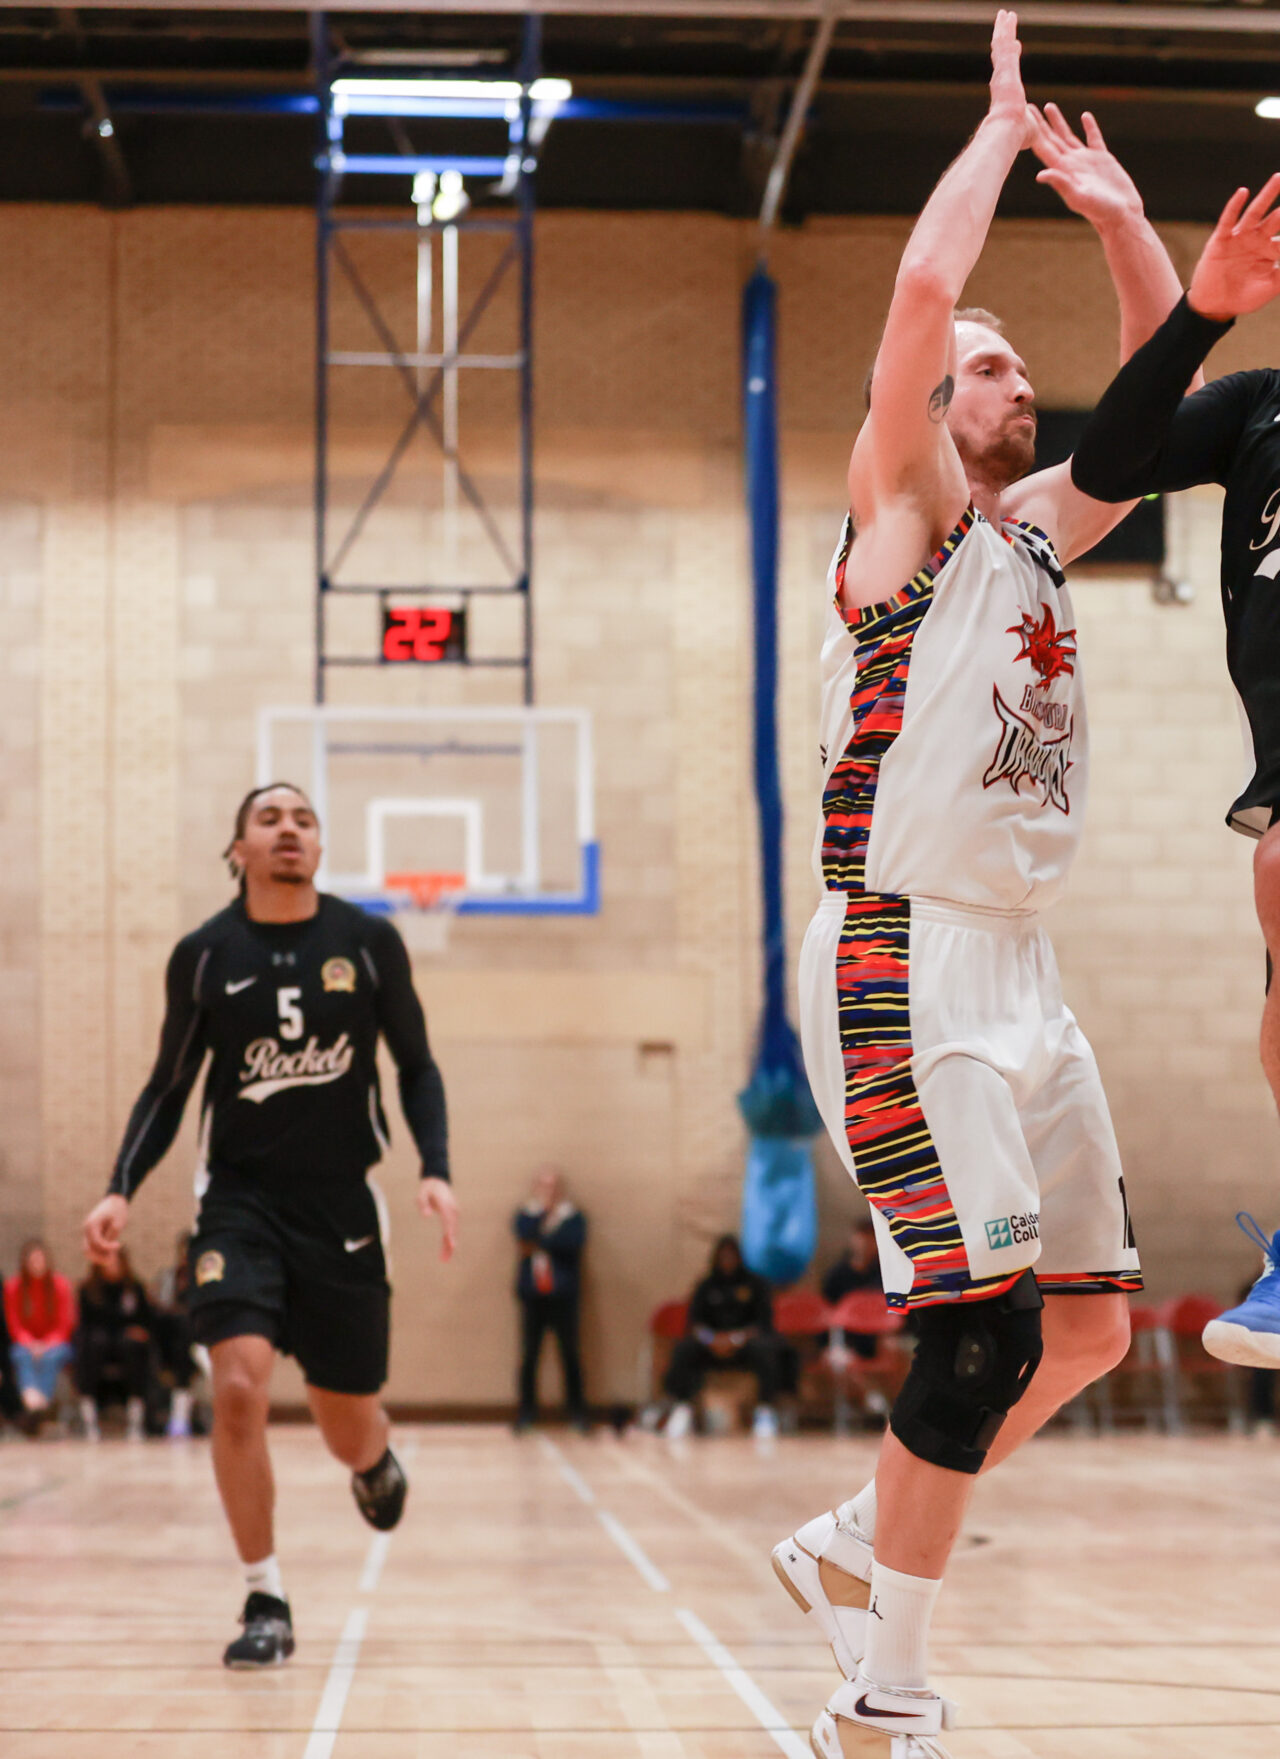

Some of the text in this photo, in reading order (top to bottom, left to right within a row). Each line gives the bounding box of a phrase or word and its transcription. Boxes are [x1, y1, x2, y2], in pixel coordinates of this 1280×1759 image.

[384, 606, 452, 661] 22
[277, 986, 304, 1040] 5
[1013, 1225, 1039, 1244] Coll
